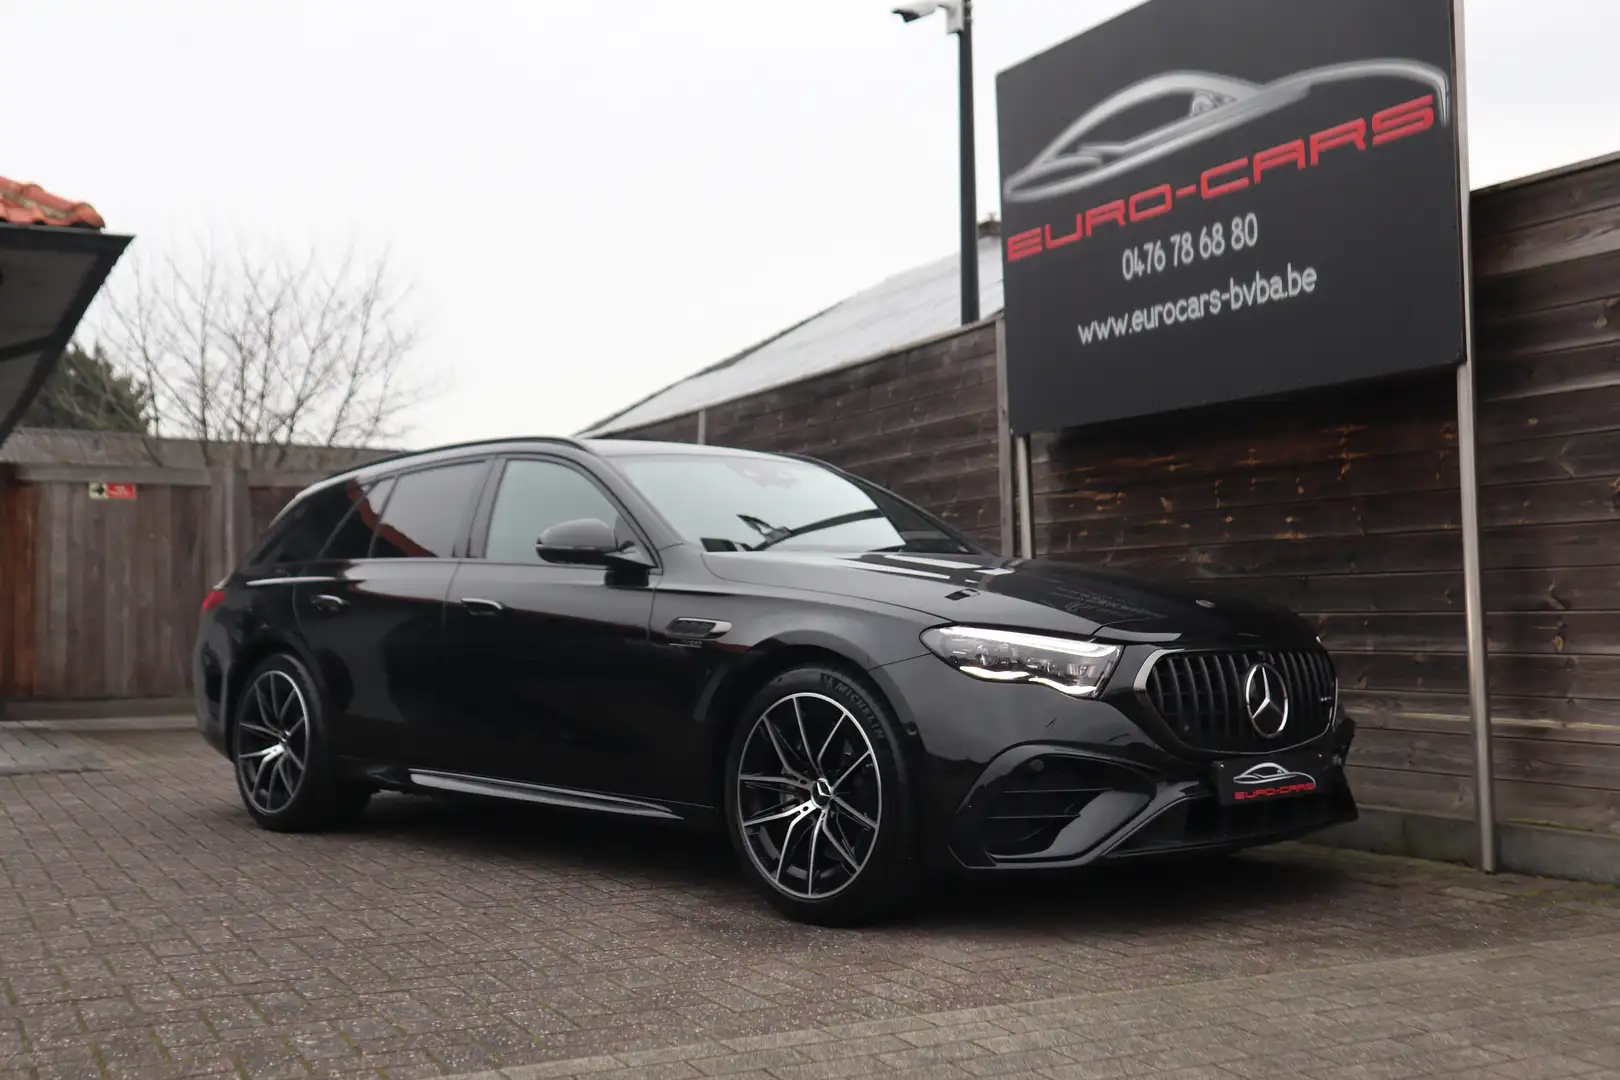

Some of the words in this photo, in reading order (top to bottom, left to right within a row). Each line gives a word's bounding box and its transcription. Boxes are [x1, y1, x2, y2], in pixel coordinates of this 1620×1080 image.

[1007, 94, 1434, 262] EURO-CARS
[1121, 239, 1166, 281] 0476
[1170, 231, 1195, 267] 78
[1199, 221, 1226, 259] 68
[1230, 212, 1260, 251] 80
[1077, 263, 1318, 345] www.eurocars-bvba.be
[834, 682, 885, 739] MICHELIN
[1233, 782, 1316, 800] EURO-CARS
